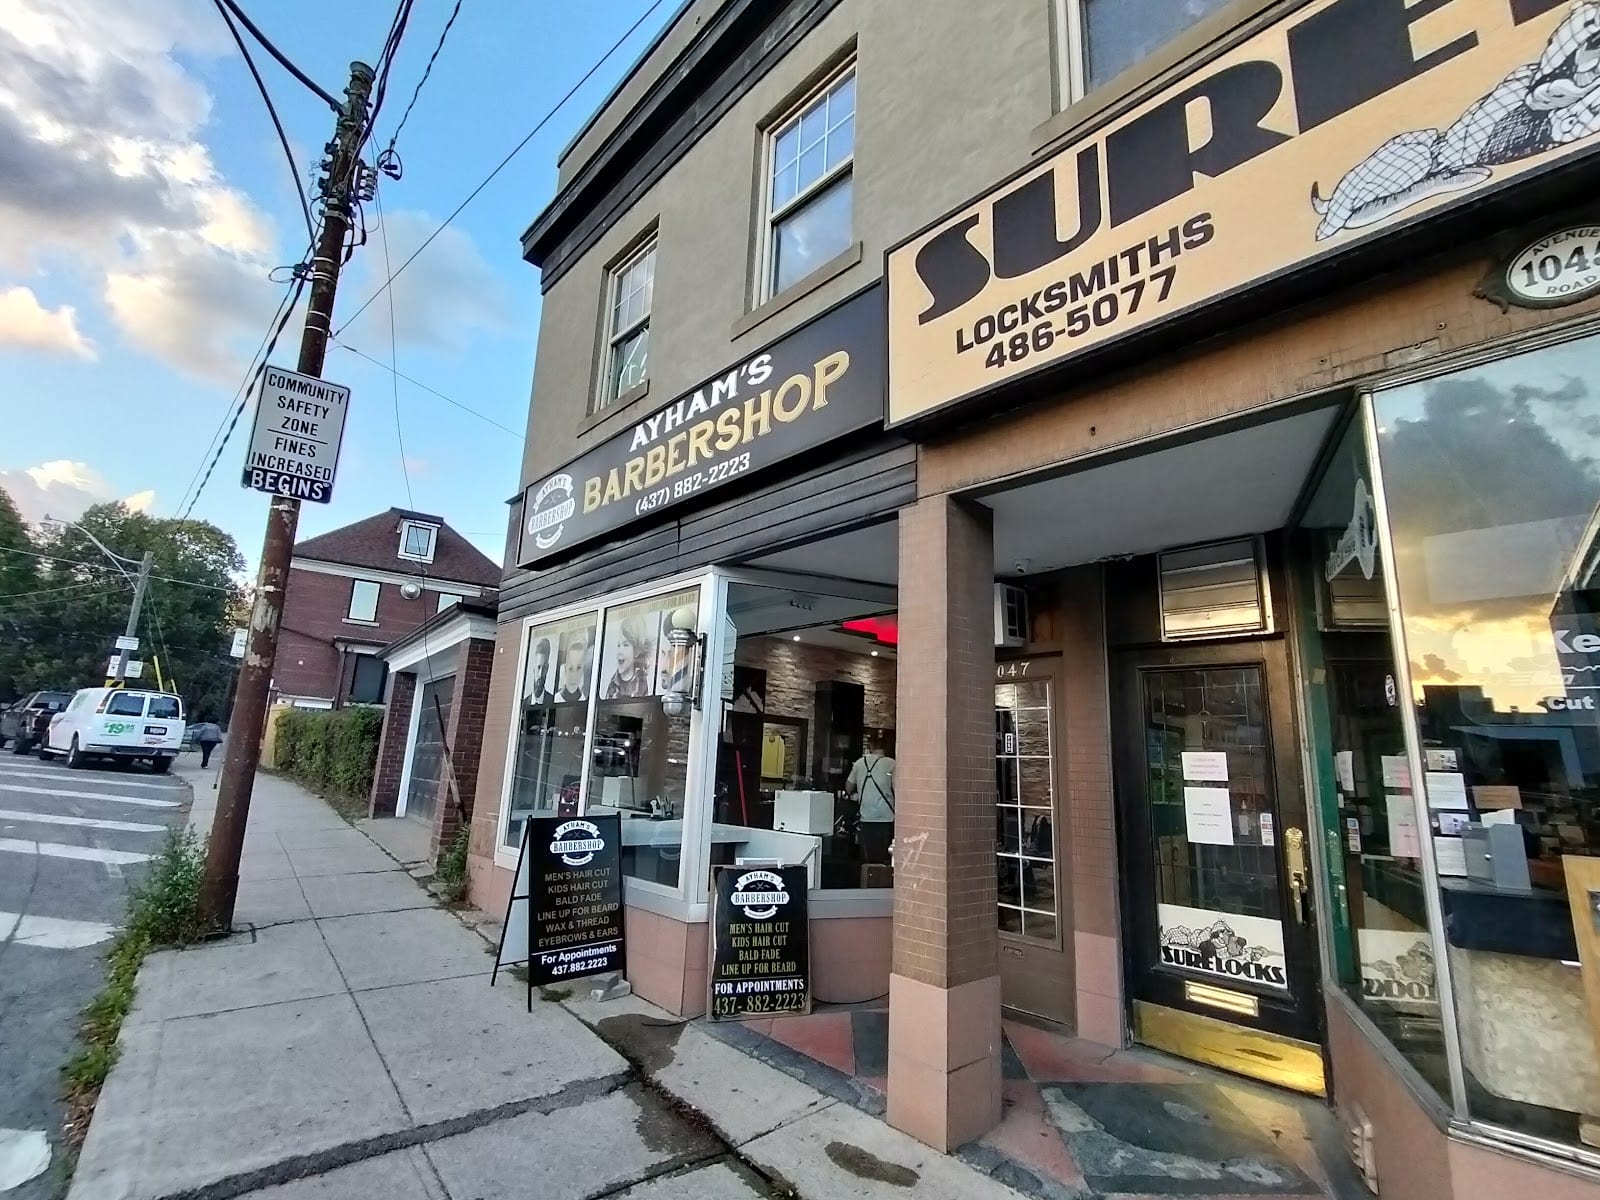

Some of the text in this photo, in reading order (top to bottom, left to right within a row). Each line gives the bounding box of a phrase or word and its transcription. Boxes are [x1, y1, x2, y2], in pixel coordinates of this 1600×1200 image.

[1533, 229, 1600, 256] AVENUE
[956, 211, 1215, 354] LOCKSMITHS
[1546, 275, 1597, 294] ROAD
[984, 266, 1177, 369] 486-5077
[268, 373, 344, 405] COMMUNITY
[277, 395, 329, 419] SAFETY
[629, 353, 773, 453] AYHAM'S
[281, 416, 318, 436] ZONE
[582, 350, 851, 515] BARBERSHOP
[275, 437, 316, 458] FINES
[251, 452, 331, 480] INCREASED
[251, 469, 323, 500] BEGINS
[635, 452, 750, 516] (437) 882-2223
[563, 821, 590, 832] AYHAM'S
[553, 839, 602, 852] BARBERSHOP
[545, 867, 610, 882] MEN'S HAIR CUT
[548, 880, 608, 894] KIDS HAIR CUT
[556, 892, 602, 906] BALD FADE
[735, 892, 786, 904] BARBERSHOP
[538, 902, 618, 922] LINE UP FOR BEARD
[546, 916, 610, 933] WAX & THREAD
[730, 922, 790, 935] MEN'S HAIR CUT
[538, 926, 618, 948] EYEBROWS & EARS
[732, 935, 788, 948] KIDS HAIR CUT
[541, 944, 616, 966] For Appointments
[739, 948, 780, 961] BALD FADE
[552, 956, 608, 976] 437.882.2223
[721, 961, 796, 976] LINE UP FOR BEARD
[714, 978, 804, 995] FOR APPOINTMENTS
[746, 992, 805, 1012] 882-2223
